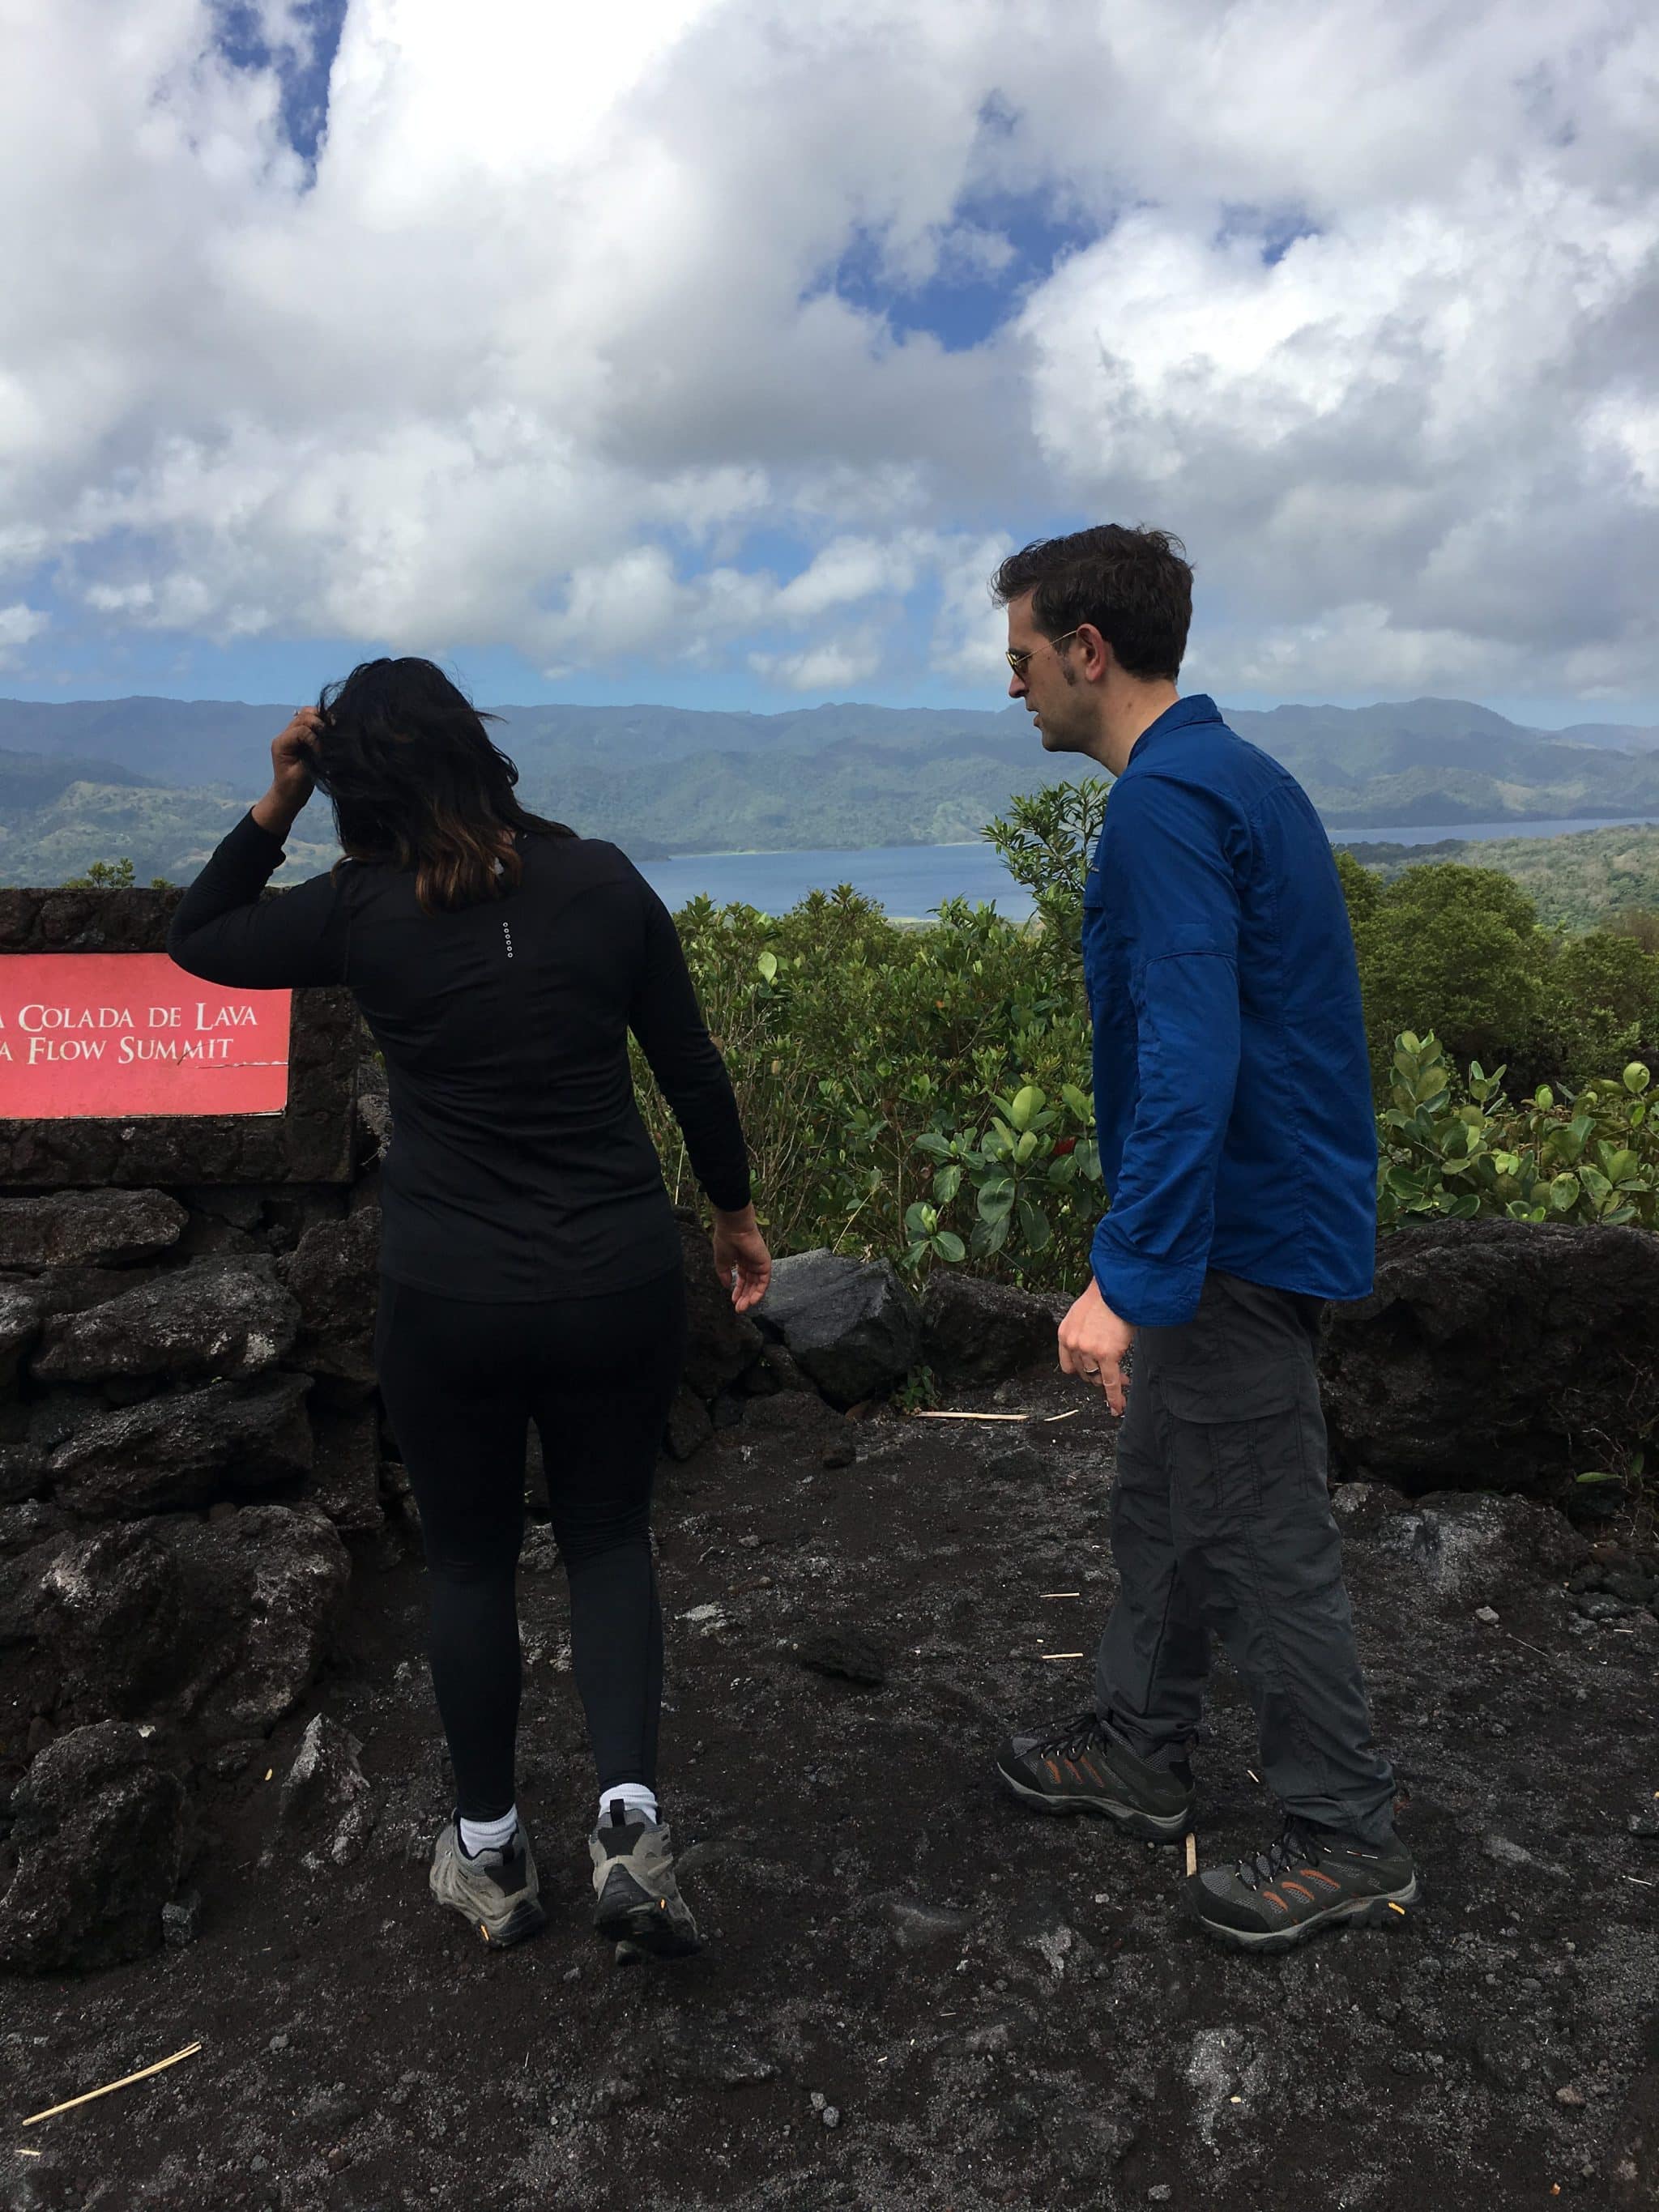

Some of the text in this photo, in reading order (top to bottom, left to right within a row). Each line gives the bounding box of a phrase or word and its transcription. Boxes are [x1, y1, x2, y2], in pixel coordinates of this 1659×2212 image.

[18, 1004, 134, 1033] COLADA
[148, 1006, 181, 1028] DE
[194, 1003, 258, 1031] LAVA
[27, 1037, 107, 1065] FLOW
[117, 1036, 234, 1064] SUMMIT
